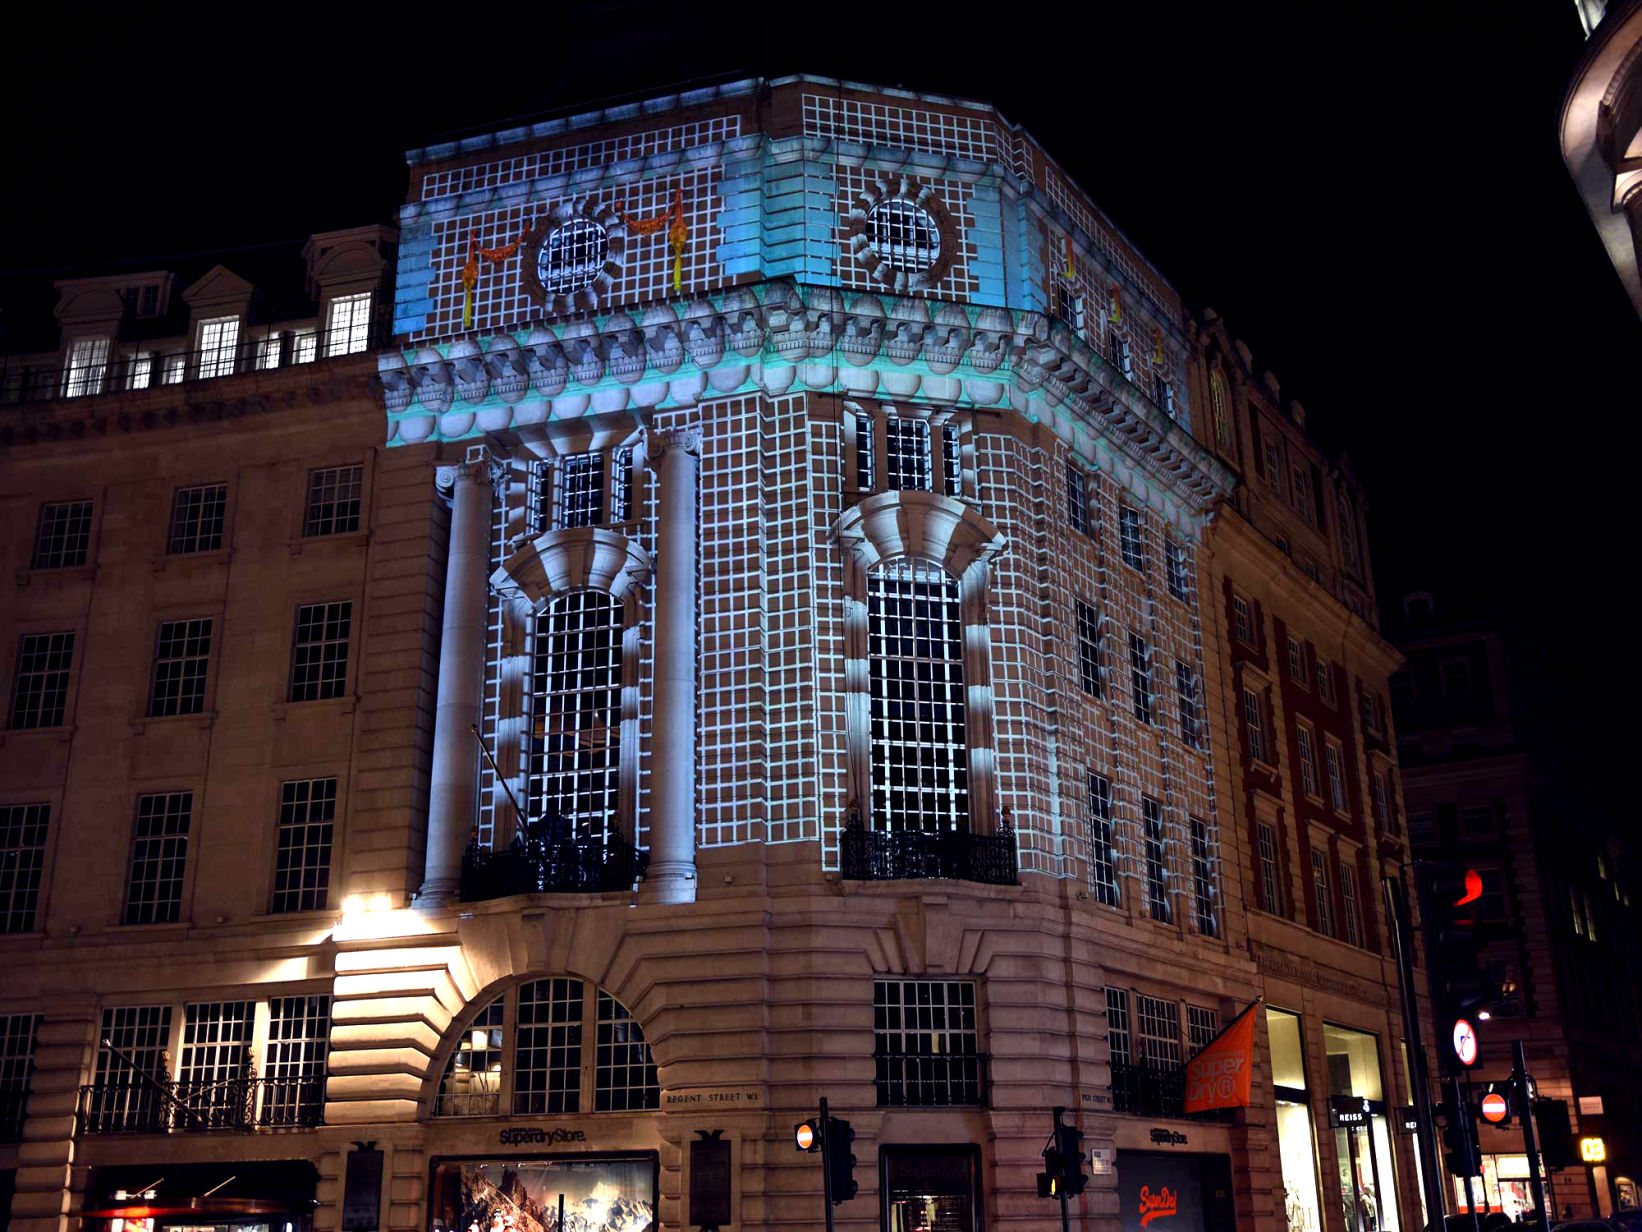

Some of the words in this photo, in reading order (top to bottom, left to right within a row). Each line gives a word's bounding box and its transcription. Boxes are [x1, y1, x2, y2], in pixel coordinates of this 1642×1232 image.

[667, 1094, 701, 1104] REGENT
[709, 1092, 740, 1102] STREET
[1339, 1113, 1363, 1122] REISS
[1405, 1121, 1417, 1129] REI
